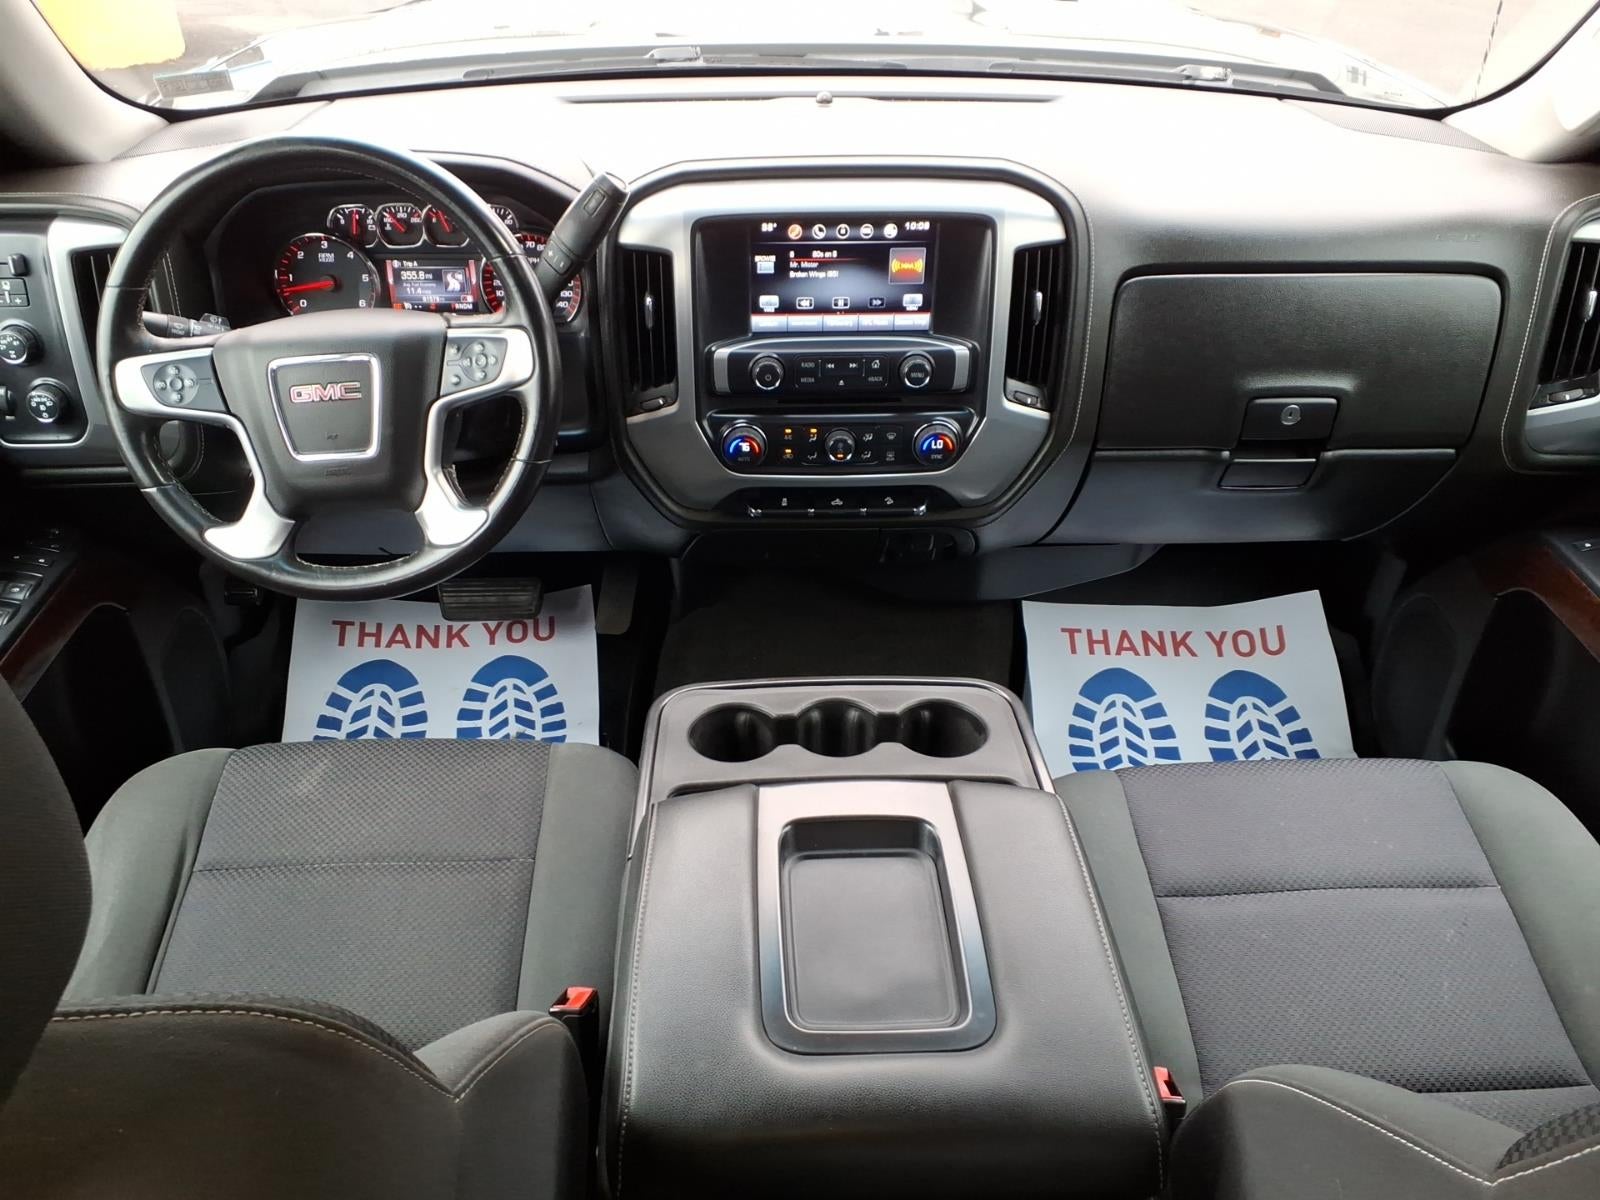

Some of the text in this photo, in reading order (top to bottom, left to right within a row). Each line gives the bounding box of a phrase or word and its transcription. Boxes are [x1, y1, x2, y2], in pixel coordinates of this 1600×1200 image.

[321, 240, 328, 249] 3
[525, 241, 535, 249] 70
[297, 251, 304, 259] 2
[346, 251, 354, 259] 4
[361, 274, 369, 282] 5
[401, 271, 425, 280] 355.8
[300, 299, 307, 308] 0
[359, 299, 366, 308] 6
[290, 381, 362, 403] GMC
[931, 439, 944, 449] LO
[332, 616, 556, 649] THANK YOU
[1060, 625, 1286, 657] THANK YOU
